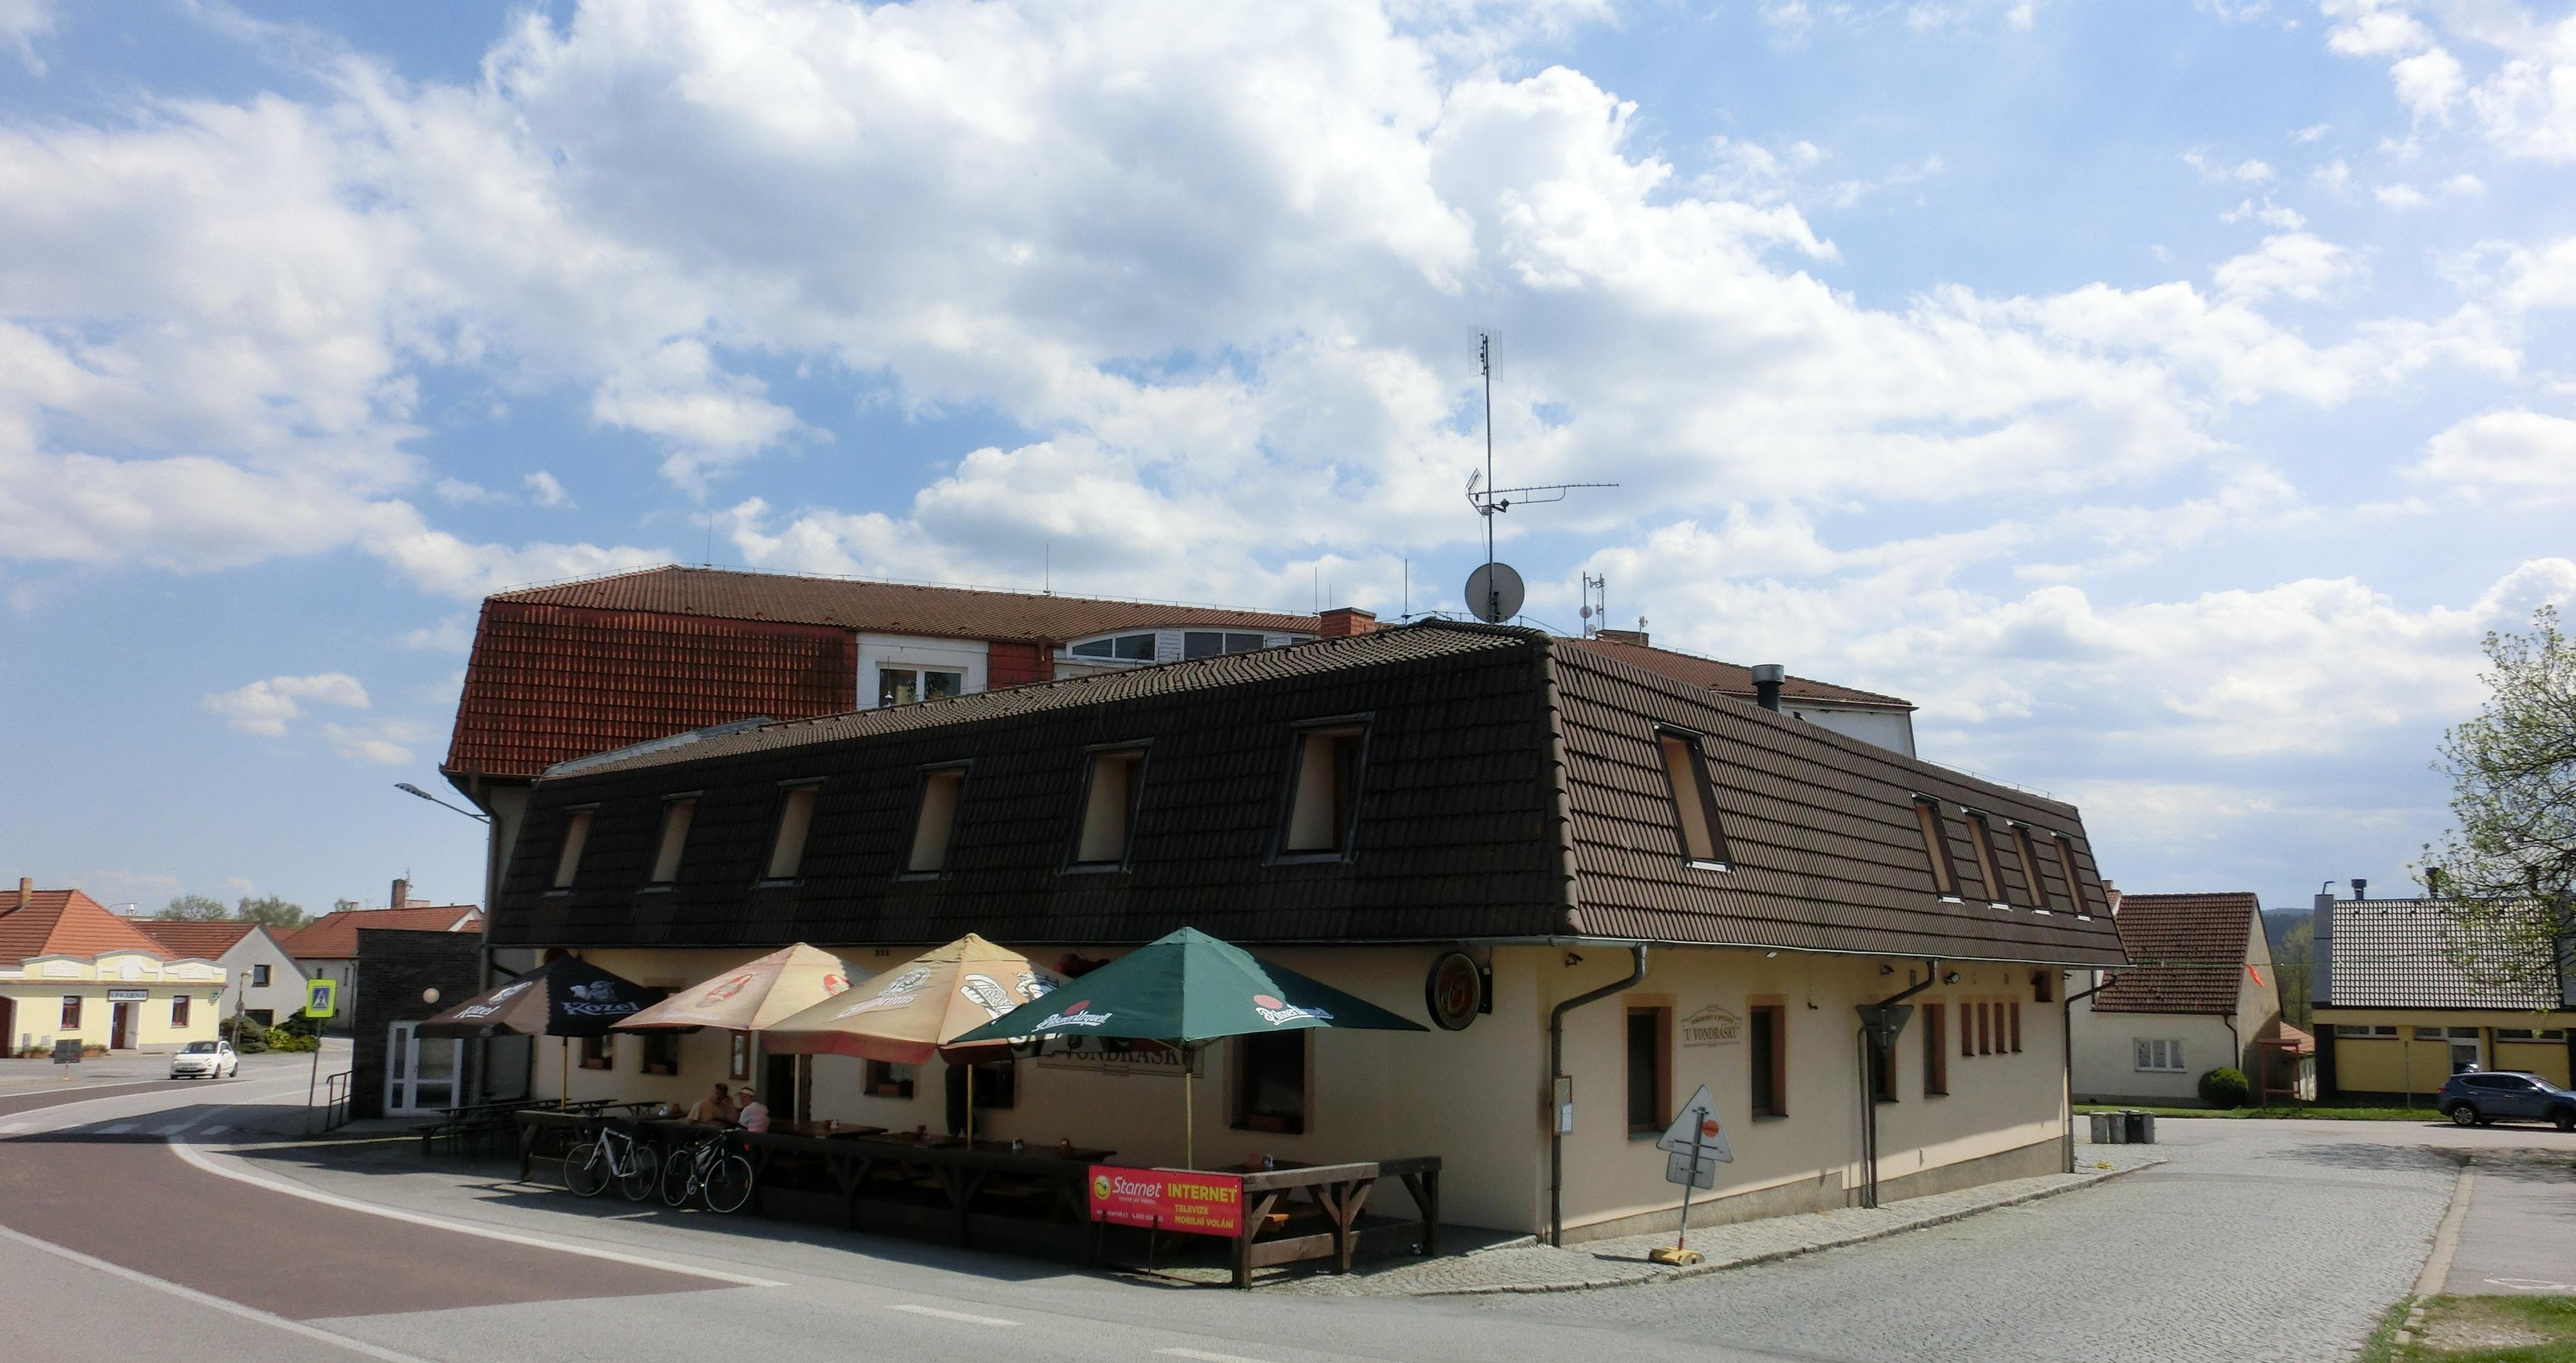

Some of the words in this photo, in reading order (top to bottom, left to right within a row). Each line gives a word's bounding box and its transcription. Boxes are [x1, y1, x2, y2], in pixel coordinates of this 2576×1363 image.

[453, 1005, 501, 1018] Kozel
[561, 1001, 643, 1016] Kozel
[1255, 1007, 1299, 1025] Pilsner
[1112, 1176, 1162, 1198] Starnet
[1168, 1183, 1238, 1203] INTERNET
[1175, 1204, 1209, 1215] TELEVIZE
[1175, 1215, 1205, 1226] MOBILNÍ
[1206, 1217, 1234, 1229] VOLÁNÍ
